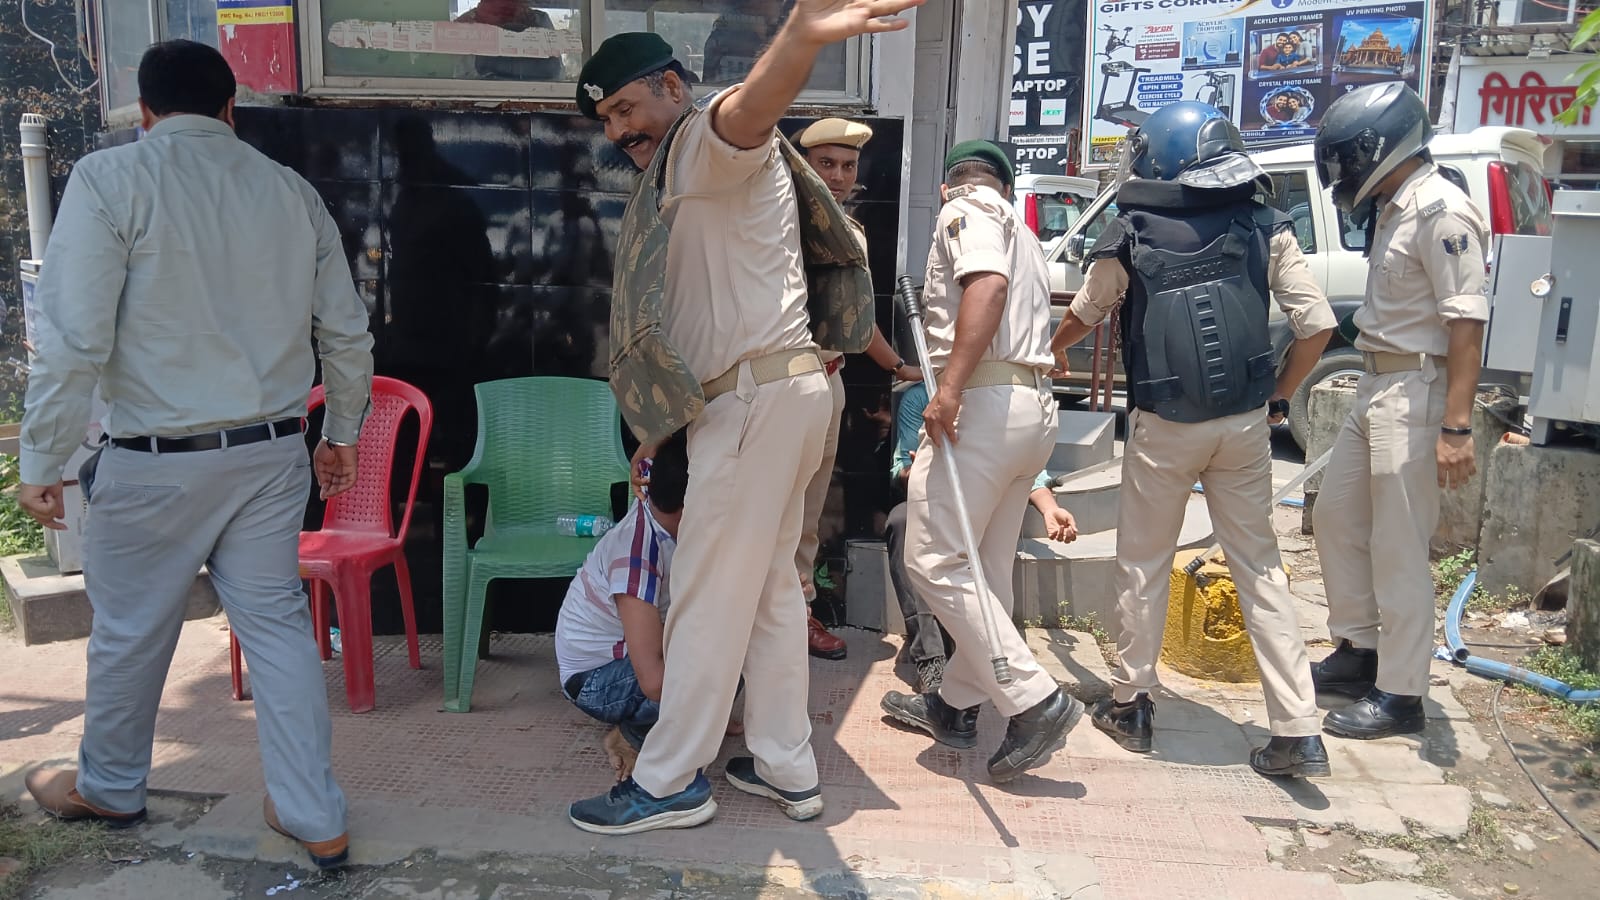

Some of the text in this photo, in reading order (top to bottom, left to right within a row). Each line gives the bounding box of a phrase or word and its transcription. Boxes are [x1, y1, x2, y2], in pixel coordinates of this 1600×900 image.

[1100, 1, 1154, 13] GIFTS
[1356, 7, 1384, 15] PRINTING
[1385, 5, 1407, 13] PHOTO
[1015, 4, 1053, 38] Y
[1253, 13, 1323, 25] ACRYLIC PHOTO FRAMES
[1140, 75, 1181, 83] TREADMILL
[1258, 80, 1282, 88] CRYSTAL
